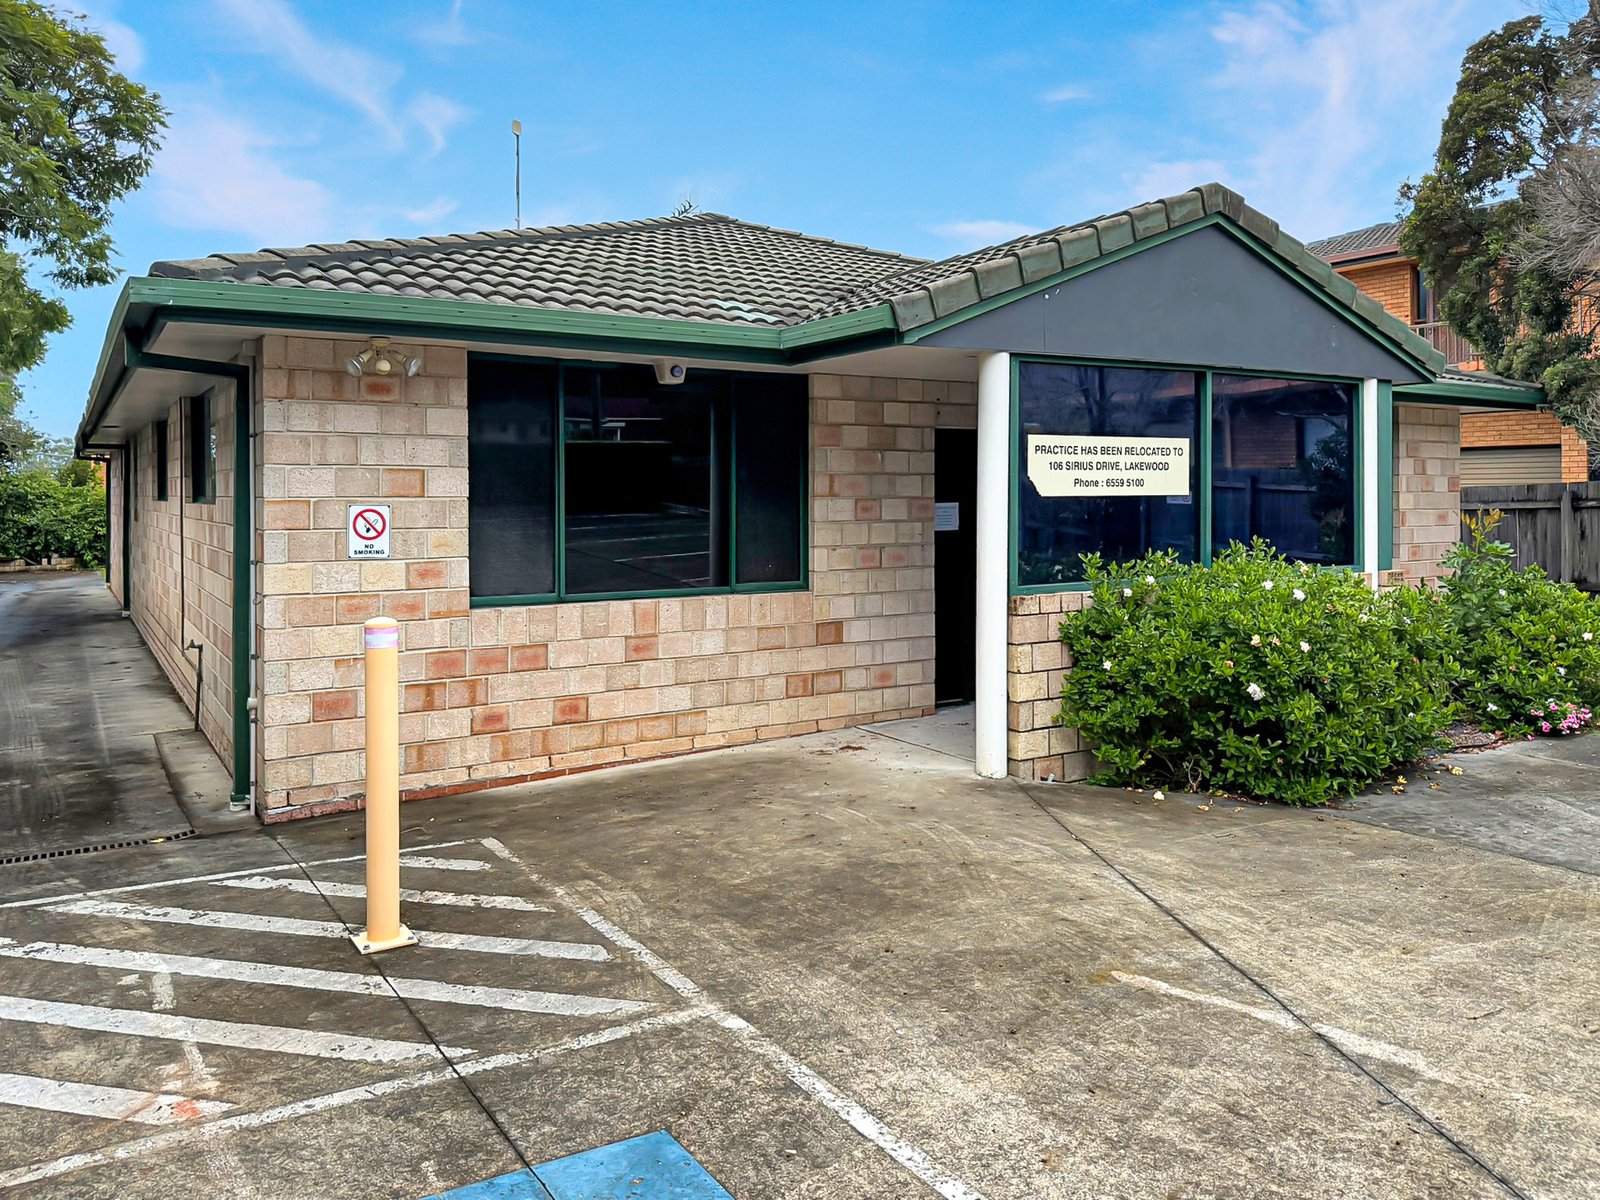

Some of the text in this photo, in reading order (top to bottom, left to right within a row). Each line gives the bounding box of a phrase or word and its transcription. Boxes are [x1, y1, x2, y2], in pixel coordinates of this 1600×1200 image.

[1035, 445, 1183, 457] PRACTICE HAS BEEN RELOCATED TO
[1049, 461, 1169, 472] 106 SIRIUS DRIVE, LAKEWOOD
[1074, 478, 1099, 487] Phone
[1106, 478, 1124, 487] 6559
[1126, 478, 1144, 487] 5100
